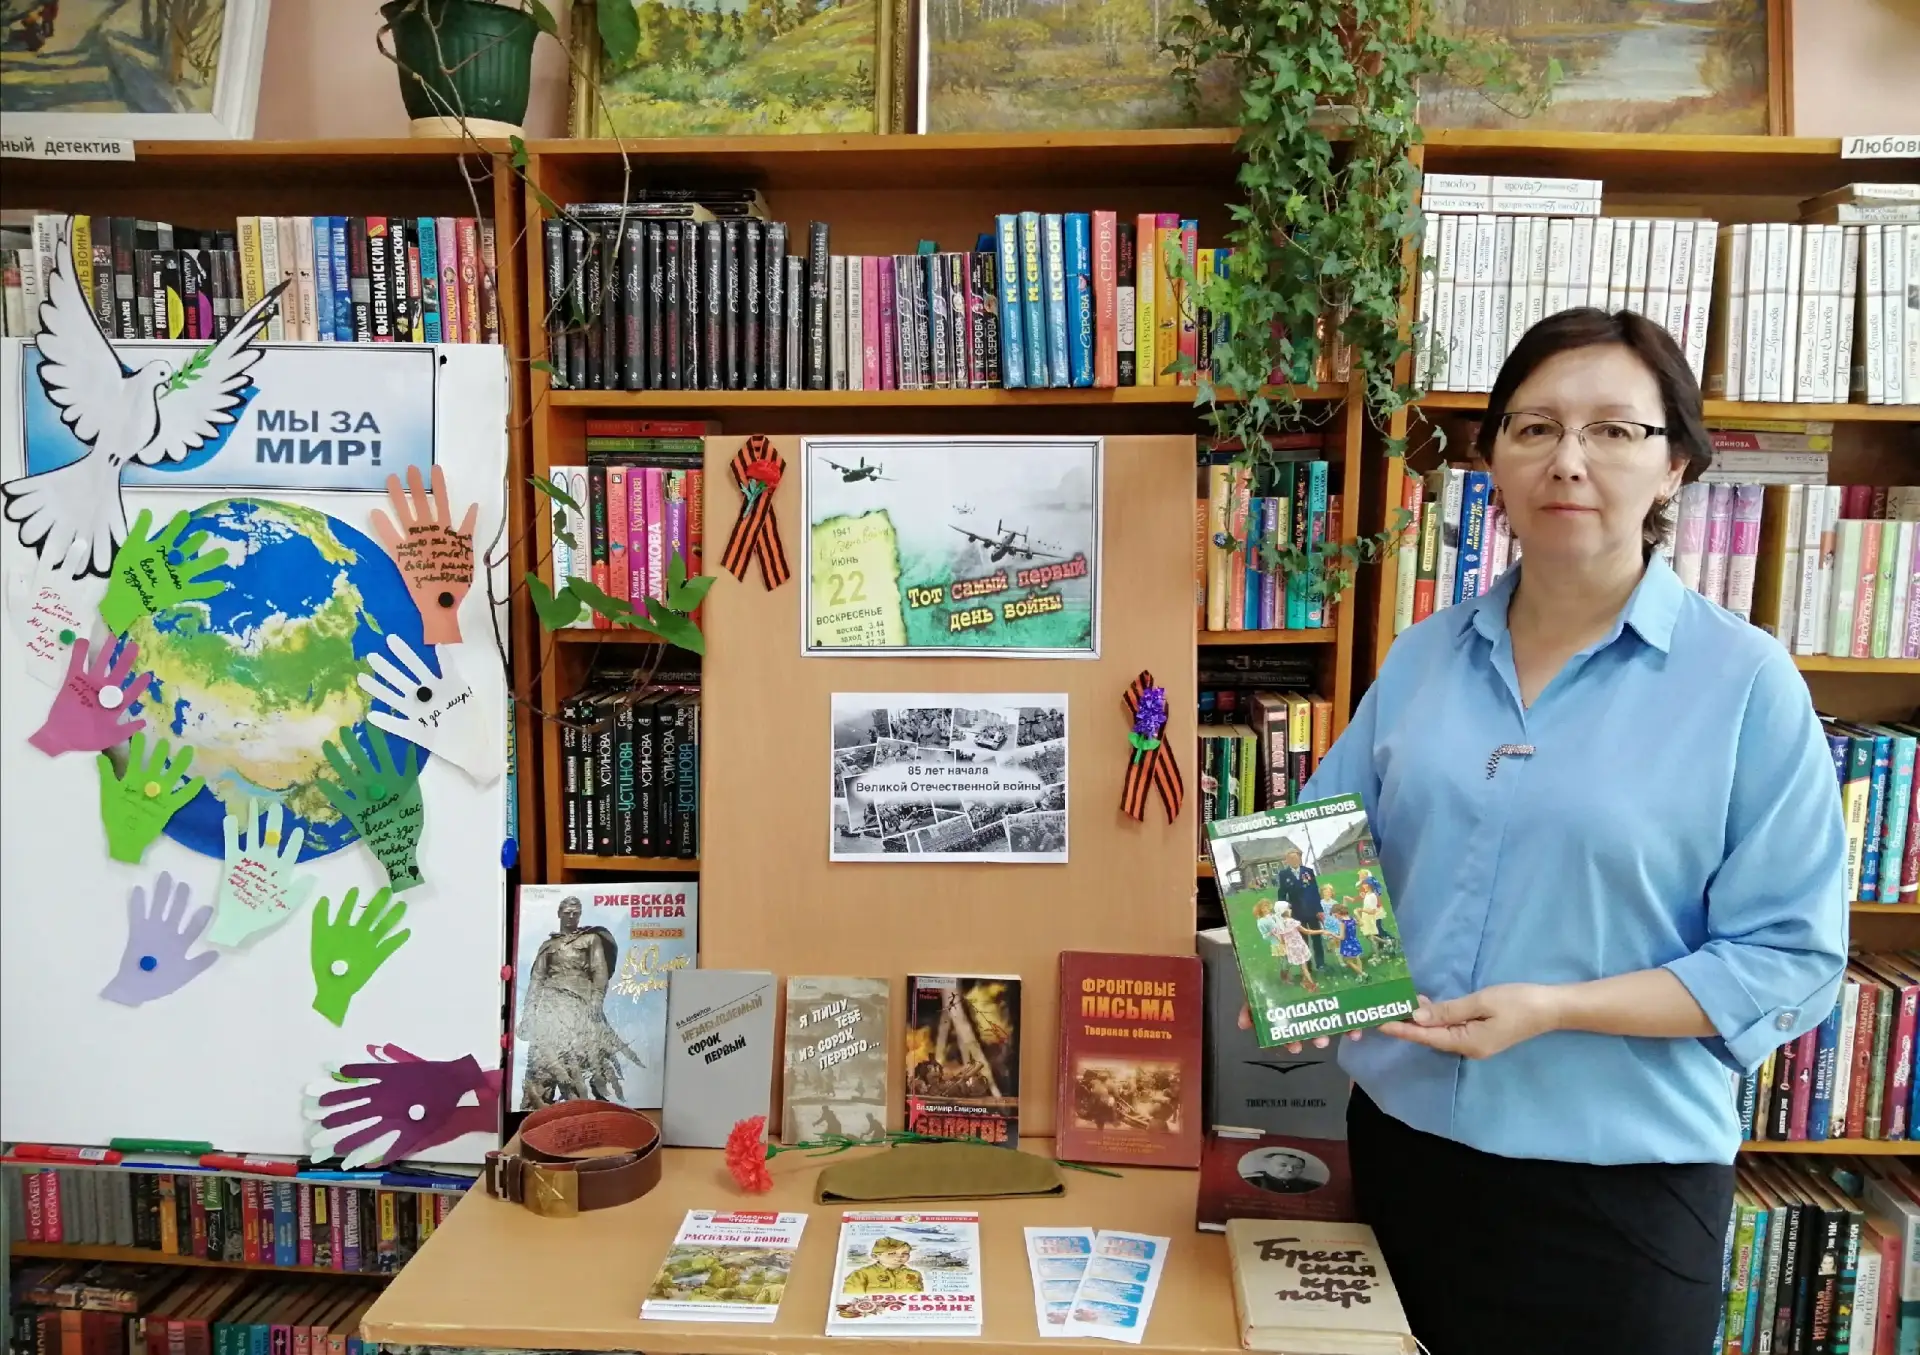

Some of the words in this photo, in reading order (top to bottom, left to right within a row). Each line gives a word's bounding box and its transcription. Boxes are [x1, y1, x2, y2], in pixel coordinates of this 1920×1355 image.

[45, 141, 121, 155] детектив
[75, 226, 89, 267] ВОИНА
[242, 224, 255, 268] НЕГОДЯЕВ
[1003, 221, 1015, 283] СЕРОВА
[1024, 220, 1037, 282] СЕРОВА
[1049, 220, 1061, 283] СЕРОВА
[1100, 219, 1112, 281] СЕРОВА
[391, 225, 407, 299] НЕЗНАНСКИЙ
[99, 272, 114, 323] Абдуллаев
[1006, 285, 1017, 303] М.
[1027, 283, 1039, 301] М.
[1105, 283, 1113, 319] Марина
[1080, 294, 1091, 348] СЕРОВА
[1122, 291, 1134, 346] СЕРОВА
[901, 320, 912, 358] СЕРОВА
[935, 318, 946, 355] СЕРОВА
[975, 318, 984, 356] СЕРОВА
[988, 317, 998, 355] СЕРОВА
[936, 358, 946, 368] М.
[975, 358, 984, 368] М.
[257, 409, 319, 433] МЫ
[330, 411, 381, 434] ЗА
[256, 437, 382, 466] МИР!
[631, 477, 643, 532] Куликова
[832, 527, 851, 538] 1941
[831, 556, 859, 567] ИЮНЬ
[827, 570, 867, 606] 22
[907, 586, 944, 609] Тот
[951, 572, 1009, 600] самый
[1017, 551, 1089, 588] первый
[816, 606, 884, 626] ВОСКРЕСЕНЬЕ
[949, 608, 994, 633] день
[1003, 591, 1063, 619] войны
[429, 709, 442, 728] за
[446, 685, 474, 711] мир!
[600, 732, 612, 787] УСТИНОВА
[641, 733, 653, 787] УСТИНОВА
[663, 729, 676, 787] УСТИНОВА
[908, 766, 922, 776] 85
[925, 767, 945, 776] лет
[948, 766, 989, 777] начала
[618, 742, 636, 812] УСТИНОВА
[677, 743, 695, 812] УСТИНОВА
[856, 780, 908, 793] Великой
[910, 780, 1000, 793] Отечественной
[1003, 781, 1041, 792] войны
[357, 793, 400, 824] Желаю
[567, 800, 576, 828] Анисимов
[1230, 815, 1278, 833] БОЛОГОЕ
[1285, 806, 1320, 824] ЗЕМЛЯ
[1320, 800, 1358, 817] ГЕРОЕВ
[365, 818, 395, 836] всем
[568, 830, 577, 850] Андрей
[586, 830, 594, 850] Андрей
[593, 893, 686, 907] РЖЕВСКАЯ
[630, 905, 687, 918] БИТВА
[1081, 978, 1176, 997] ФРОНТОВЫЕ
[799, 1014, 809, 1029] Я
[812, 998, 849, 1024] ПИШУ
[834, 1008, 863, 1029] ТЕБЕ
[1081, 995, 1175, 1022] ПИСЬМА
[1266, 996, 1340, 1023] СОЛДАТЫ
[1269, 1014, 1343, 1041] ВЕЛИКОЙ
[1345, 999, 1414, 1026] ПОБЕДЫ
[688, 1032, 722, 1056] СОРОК
[799, 1045, 816, 1062] ИЗ
[817, 1027, 856, 1053] СОРОК
[1084, 1025, 1129, 1037] Тверская
[1132, 1027, 1172, 1040] область
[704, 1034, 747, 1065] ПЕРВЫЙ
[916, 1103, 953, 1113] Владимир
[953, 1105, 988, 1113] Смирнов
[1245, 1099, 1288, 1108] ТВЕРСКАЯ
[345, 1190, 358, 1248] ЛИТВИНОВЫ
[683, 1233, 741, 1243] РАССКАЗЫ
[743, 1234, 752, 1242] О
[1297, 1262, 1377, 1278] ская
[908, 1302, 973, 1312] ВОЙНЕ
[1274, 1289, 1371, 1309] пость
[1856, 1274, 1867, 1312] ЛОЖЬ
